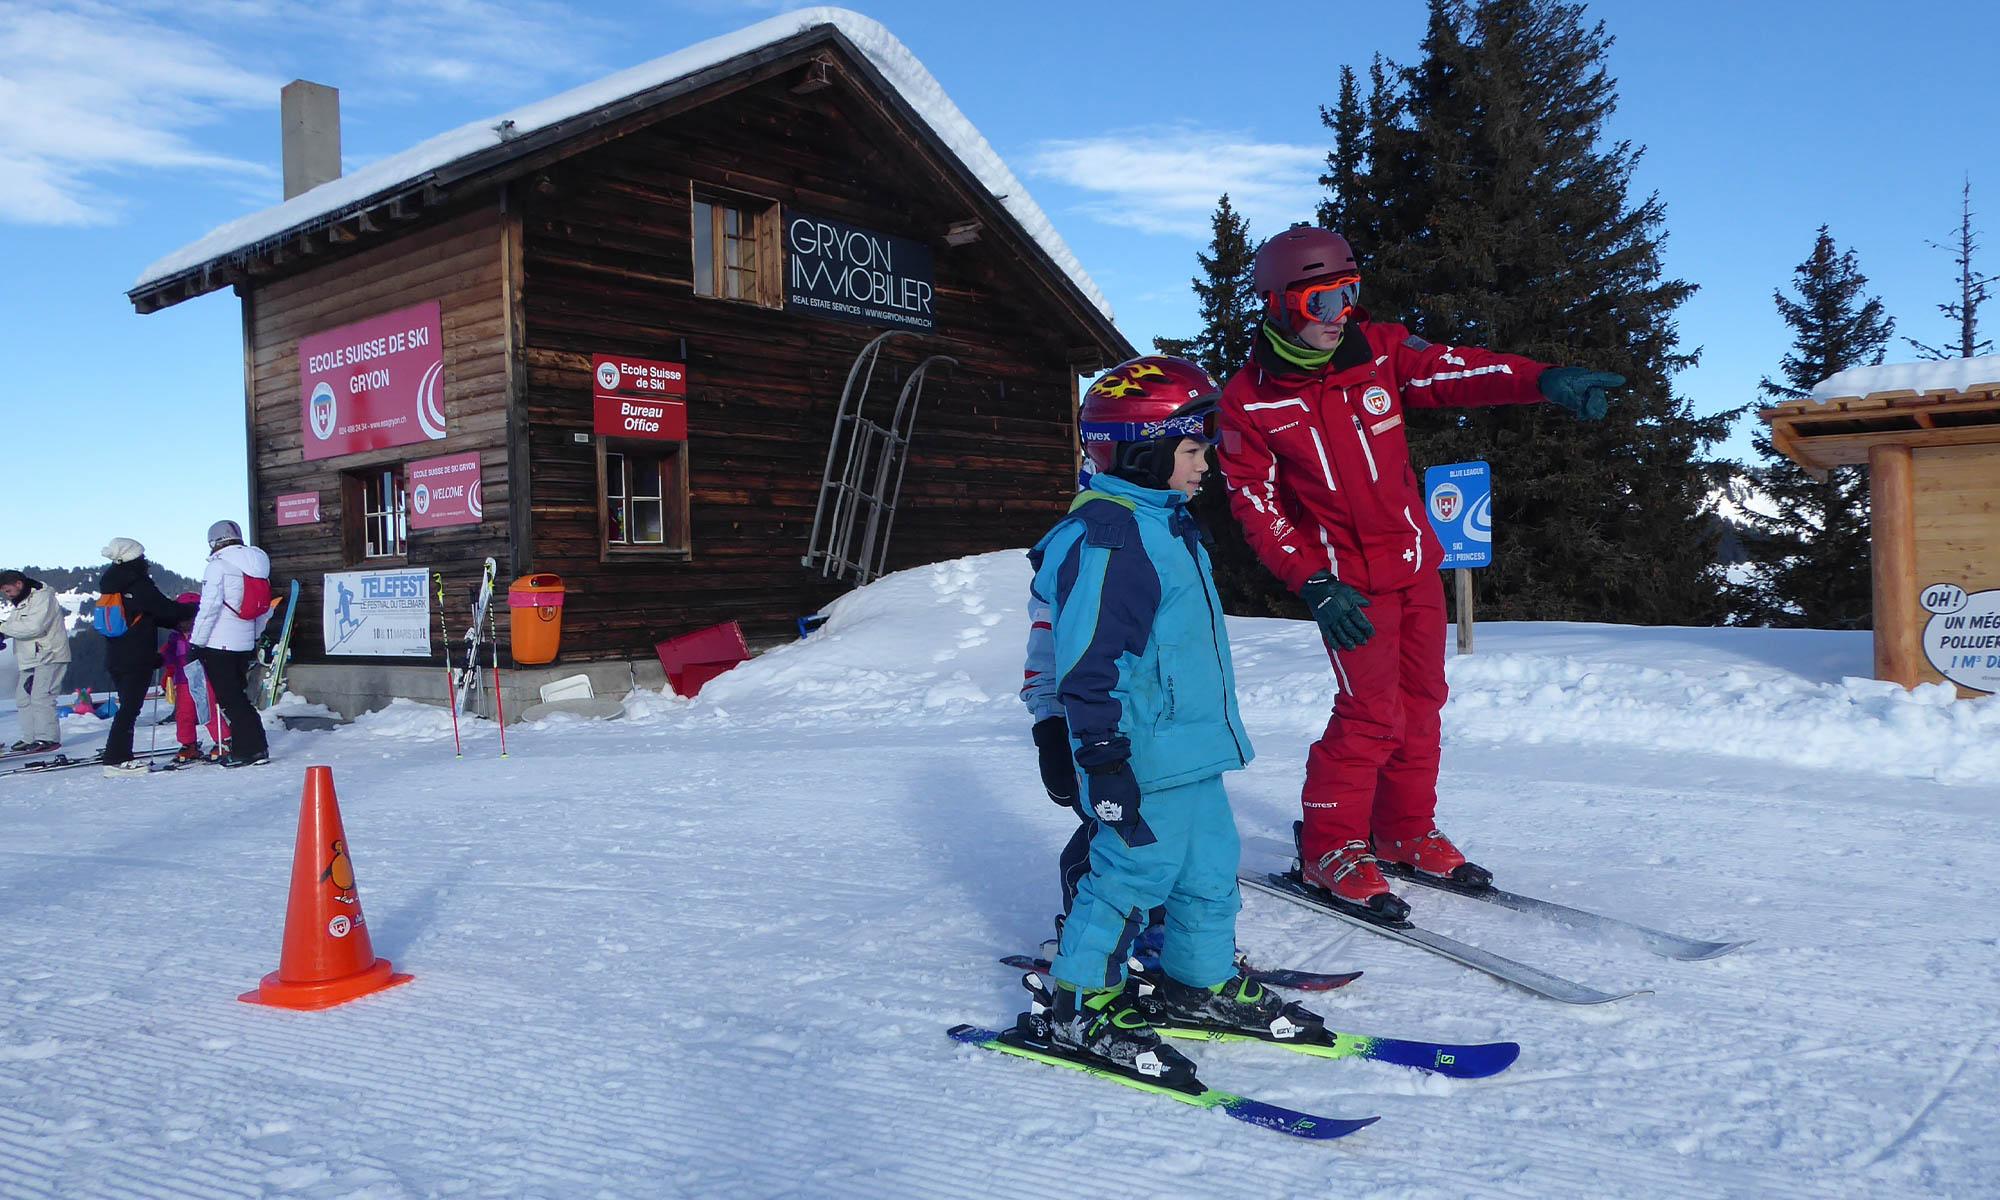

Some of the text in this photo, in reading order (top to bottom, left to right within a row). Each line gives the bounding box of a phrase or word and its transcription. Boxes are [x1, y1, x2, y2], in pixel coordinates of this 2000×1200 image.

[791, 219, 892, 272] GRYON
[792, 254, 931, 313] IMMOBILIER
[792, 294, 809, 306] REAL
[810, 298, 830, 310] ESTATE
[832, 302, 861, 314] SERVICES
[310, 326, 428, 374] ECOLE SUISSE DE SKI
[621, 363, 681, 380] Ecole Suisse
[350, 368, 390, 394] GRYON
[636, 378, 665, 390] de Ski
[621, 403, 663, 418] Bureau
[624, 418, 659, 432] Office
[1086, 432, 1111, 441] uvex
[1464, 468, 1484, 476] LEAGUE
[432, 486, 464, 500] WELCOME
[1452, 542, 1462, 550] SKI
[1456, 552, 1485, 561] PRINCESS
[361, 575, 426, 598] TELEFEST
[399, 600, 426, 608] TELEMARK
[1944, 616, 1966, 629] UN
